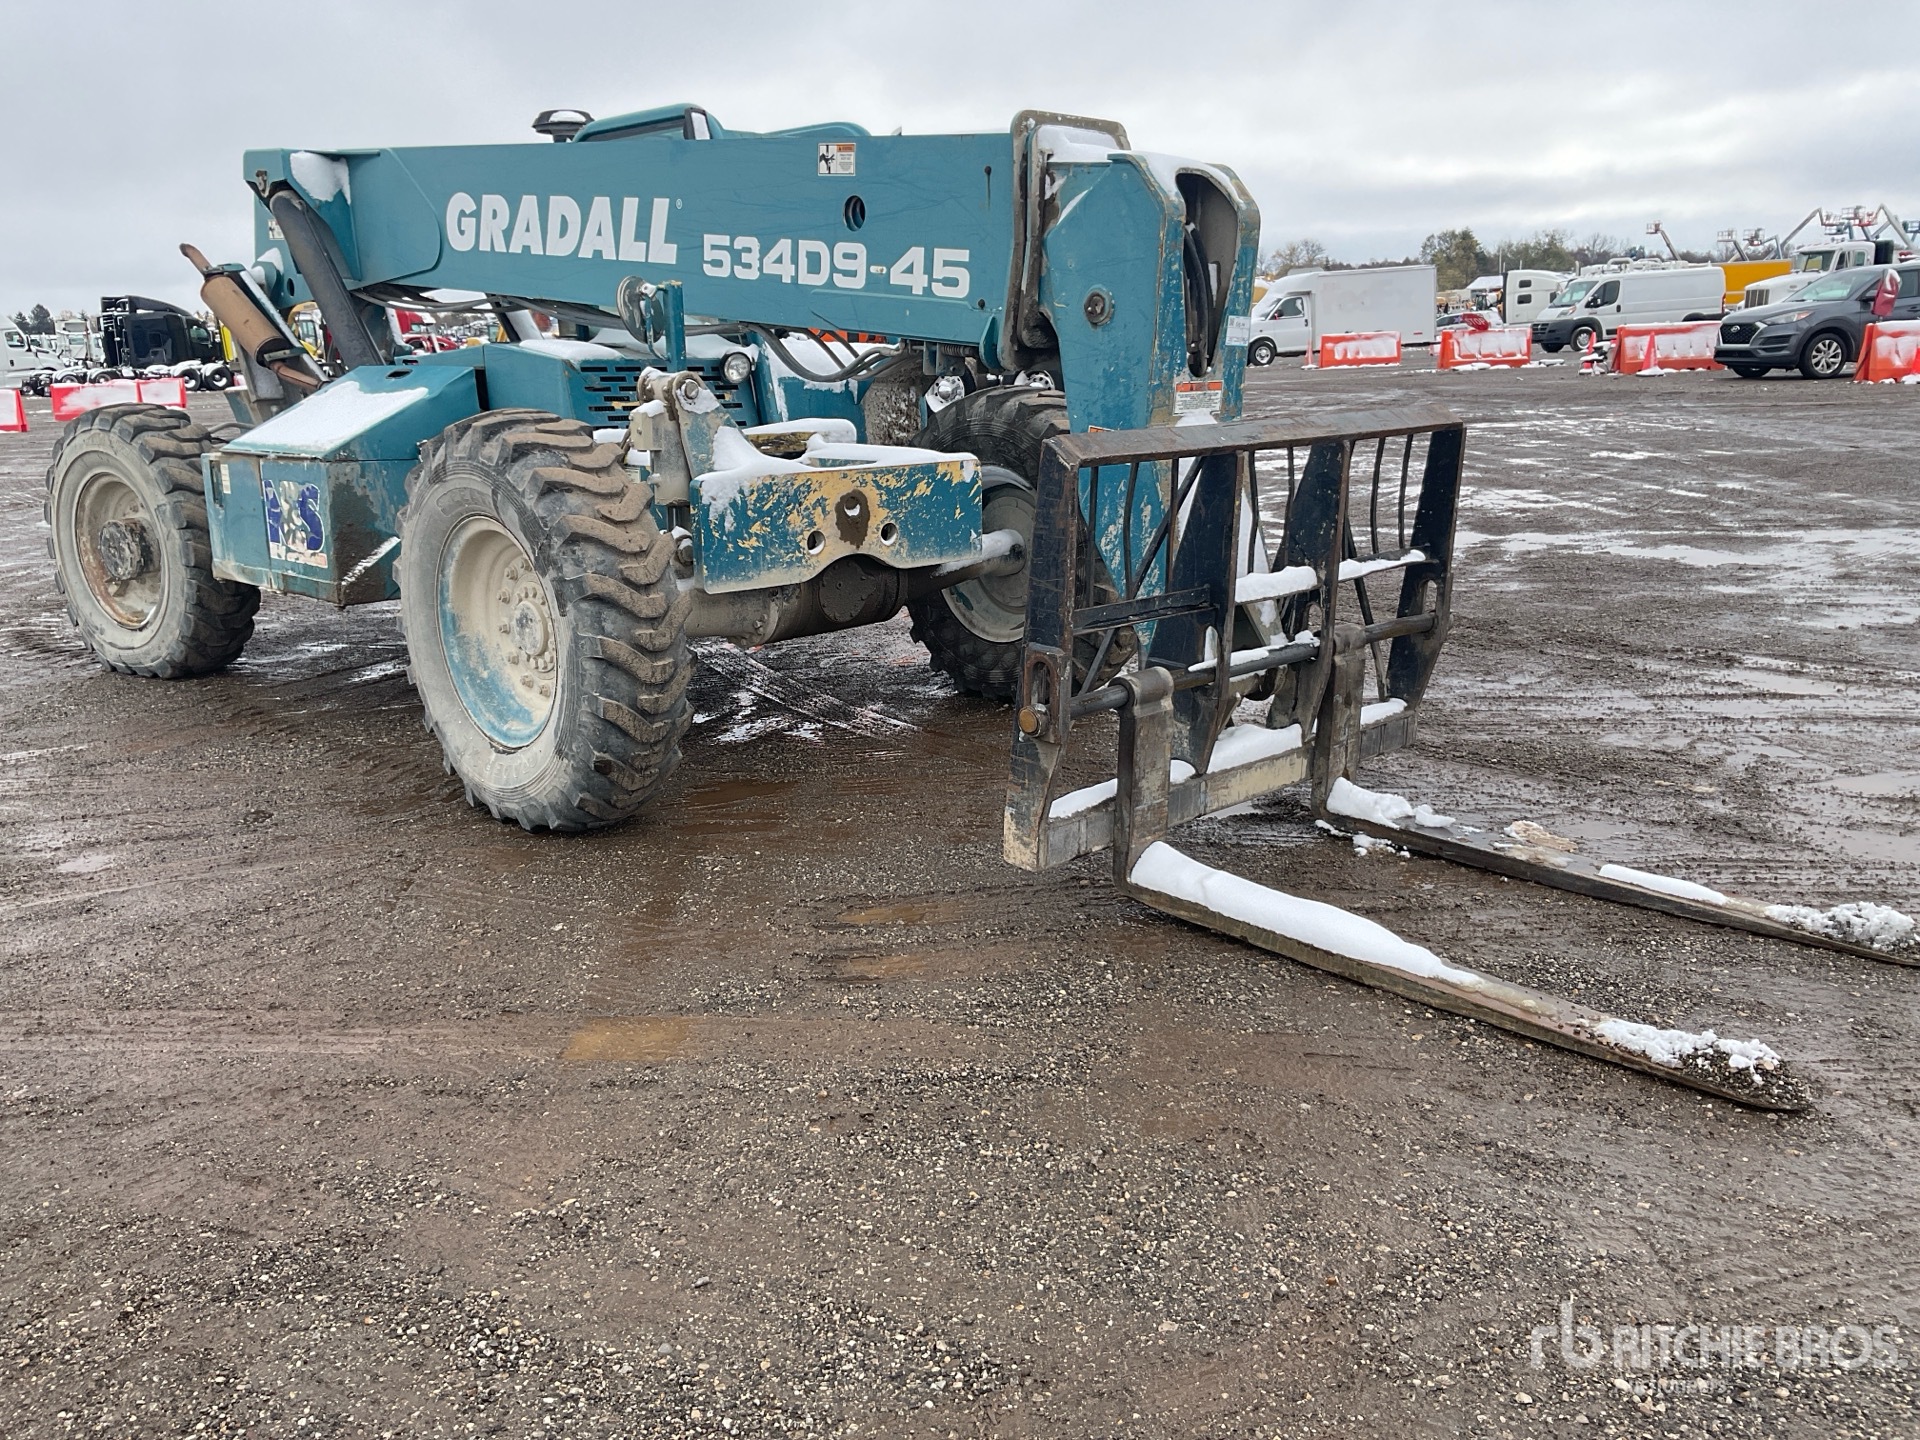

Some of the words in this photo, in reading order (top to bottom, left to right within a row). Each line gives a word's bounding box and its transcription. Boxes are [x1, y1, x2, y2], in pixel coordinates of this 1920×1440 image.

[446, 192, 678, 264] GRADALL
[702, 234, 971, 299] 534D9-45
[1464, 317, 1486, 326] STOP
